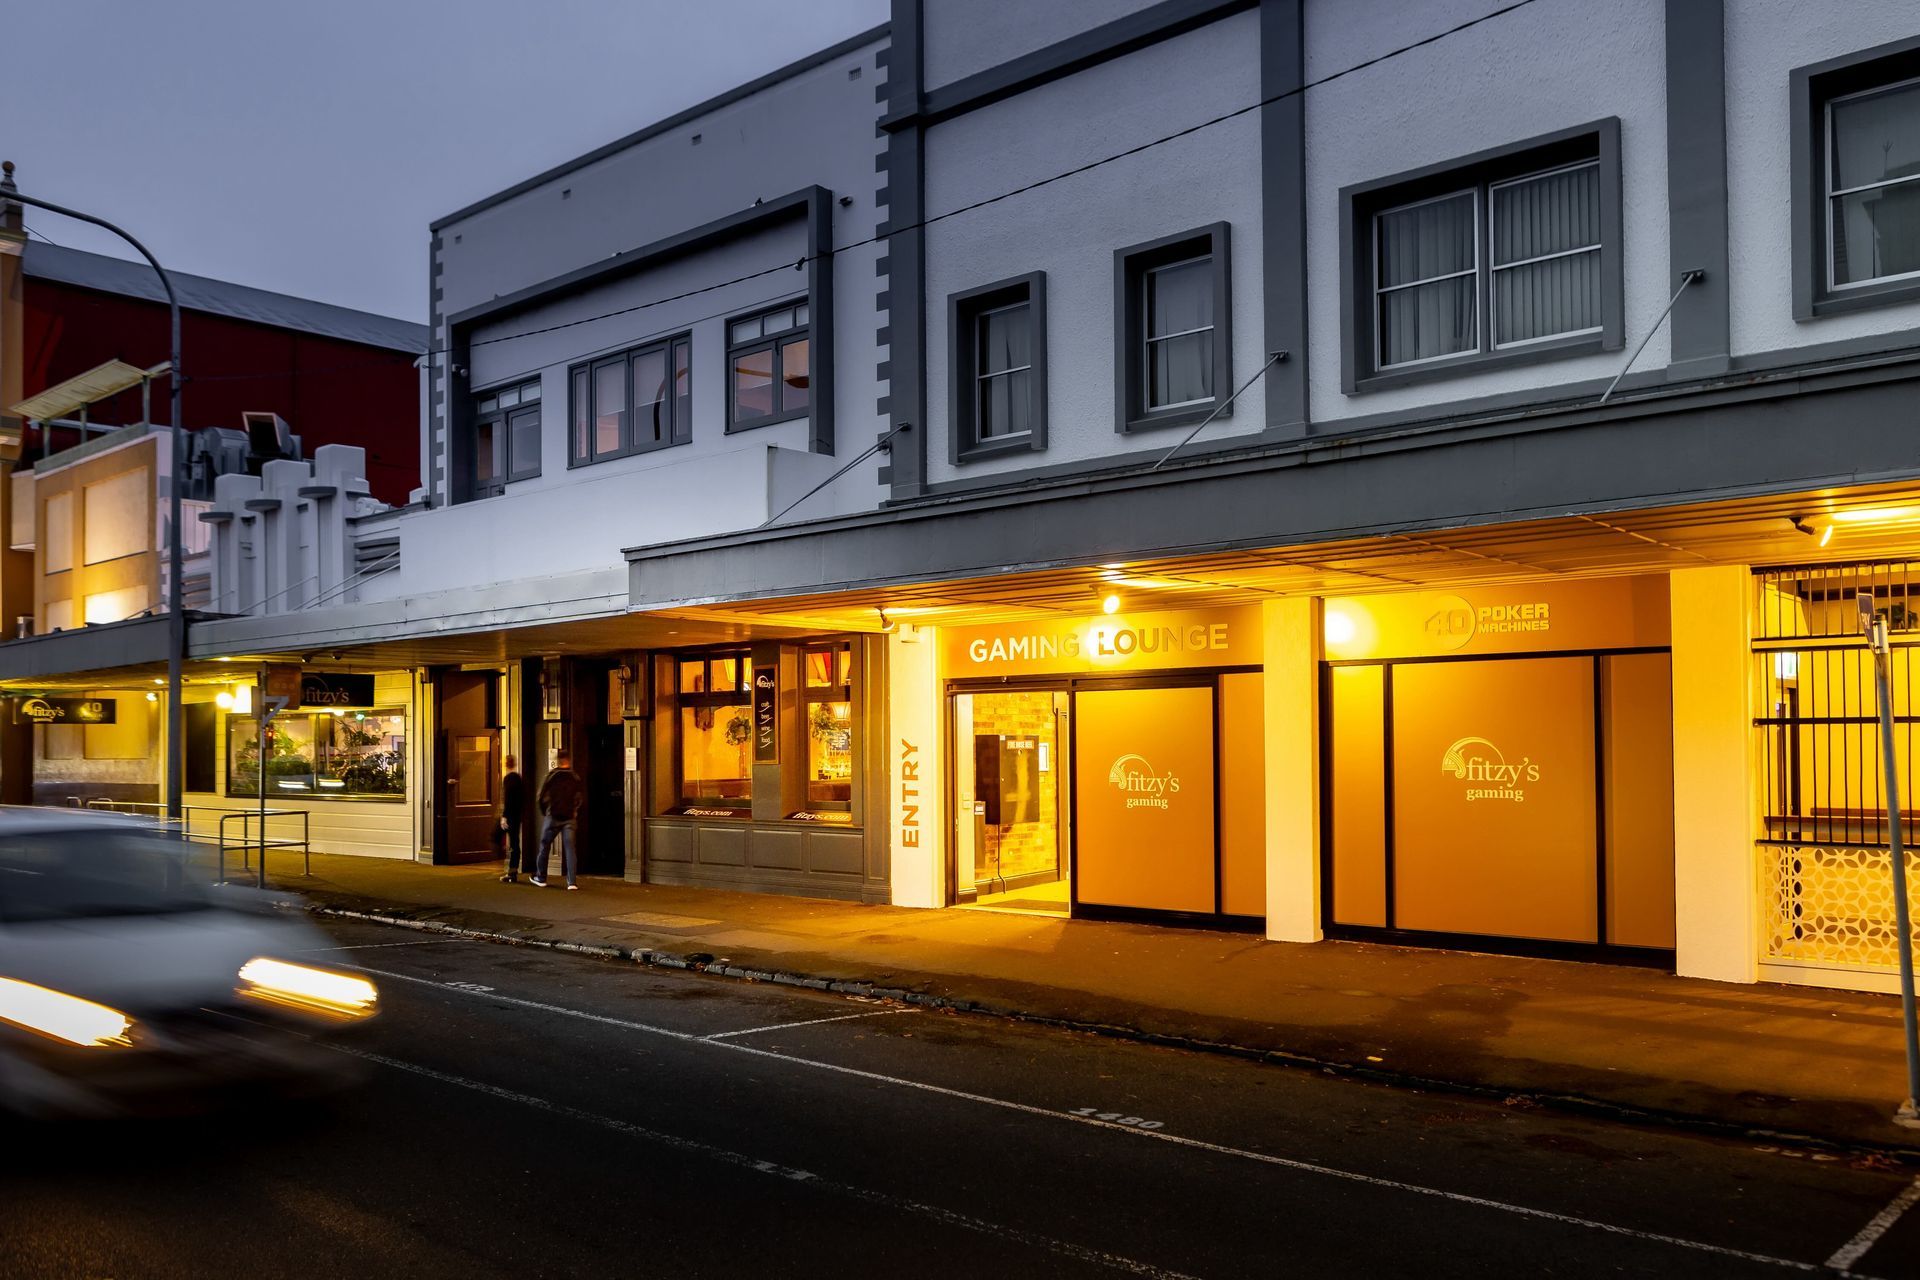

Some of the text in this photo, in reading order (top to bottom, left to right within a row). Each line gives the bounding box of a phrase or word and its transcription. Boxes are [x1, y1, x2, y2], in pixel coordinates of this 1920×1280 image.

[1425, 603, 1550, 635] 40 POKER
[1478, 620, 1550, 634] MACHINES
[969, 623, 1229, 663] GAMING LOUNGE
[305, 687, 350, 706] fitzy's
[1127, 771, 1180, 797] fitzy's
[1466, 757, 1541, 788] fitzy's
[901, 738, 919, 848] ENTRY
[1126, 795, 1169, 810] gaming
[1466, 785, 1524, 802] gaming
[1068, 1107, 1165, 1128] 1480
